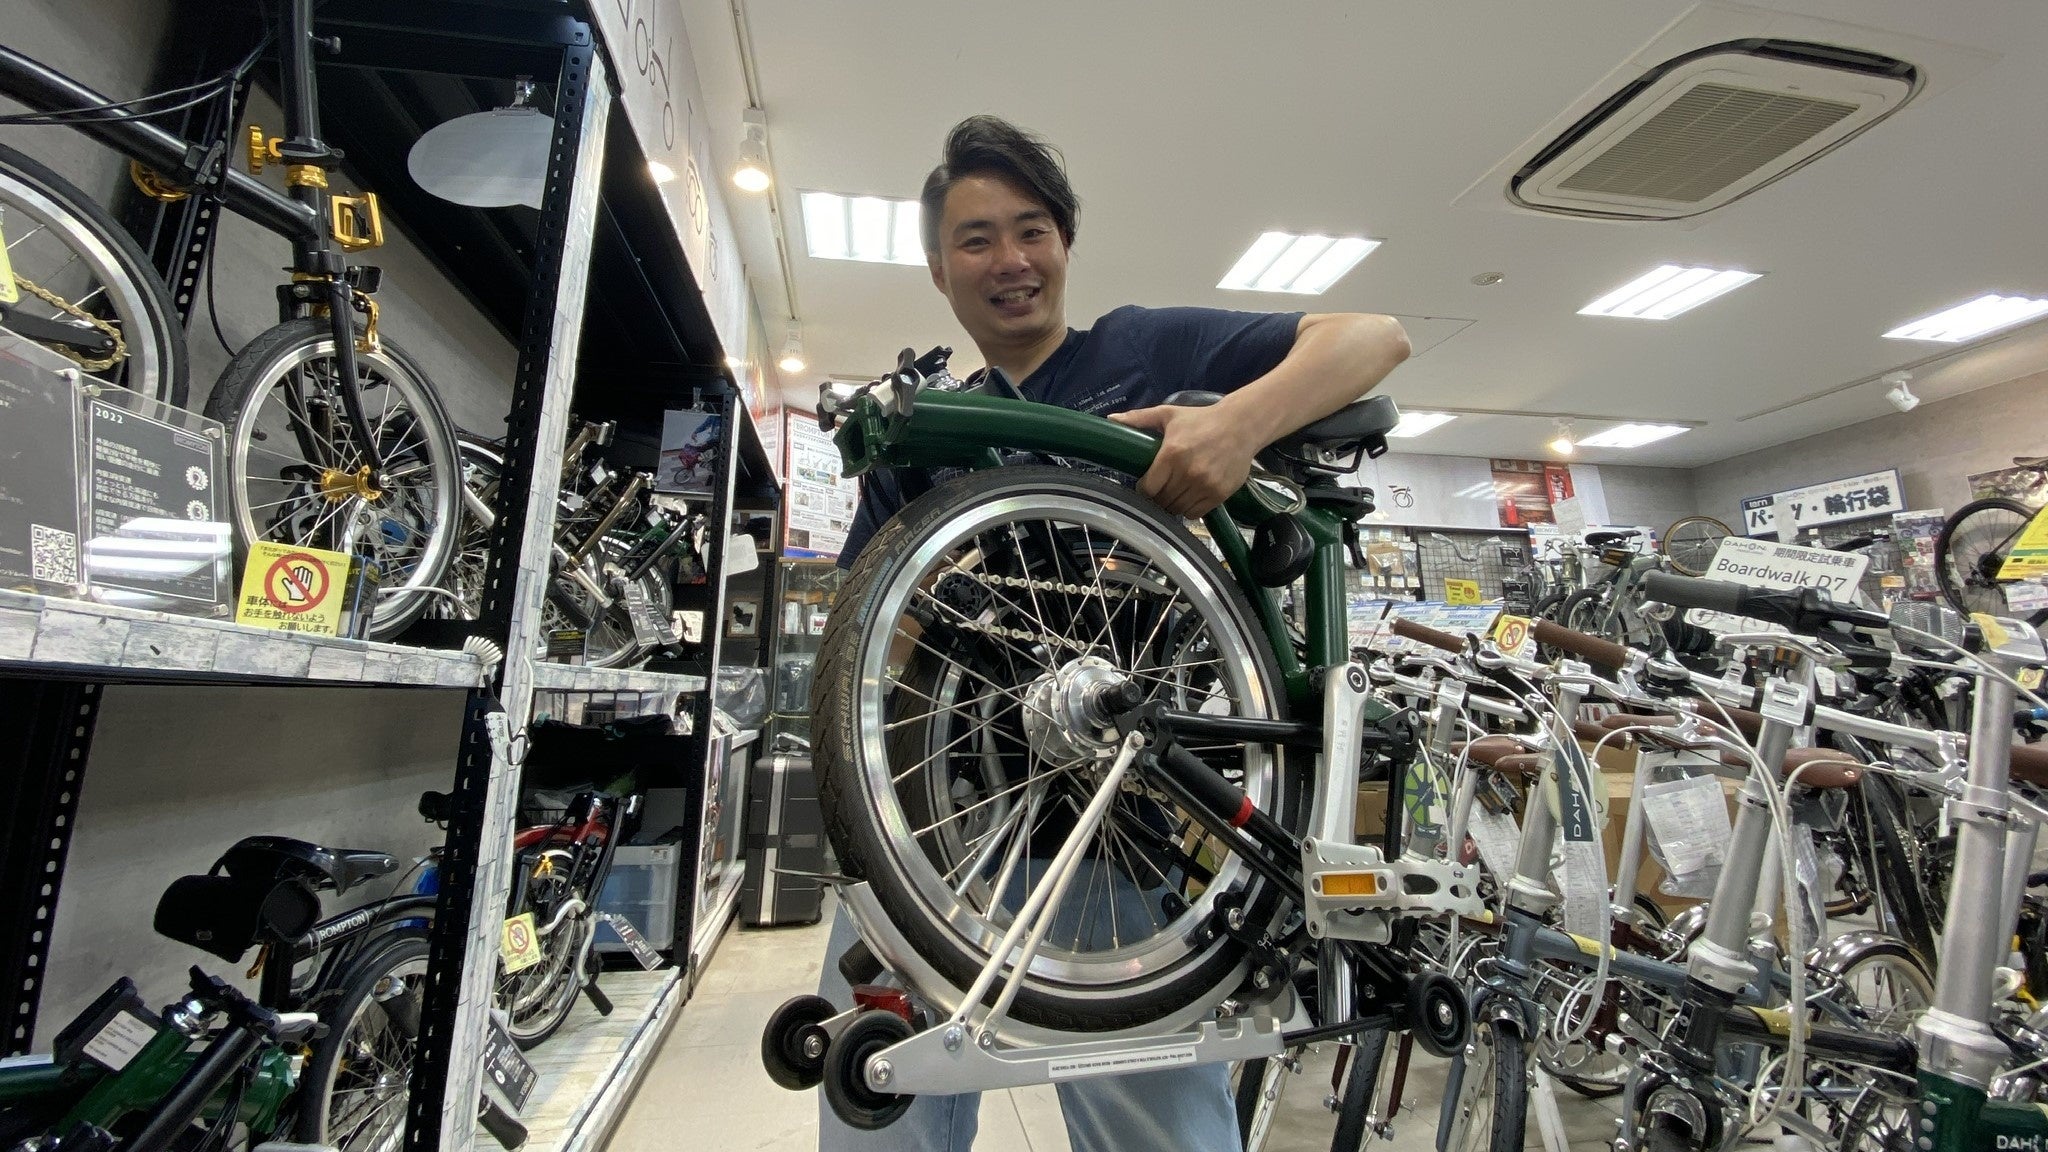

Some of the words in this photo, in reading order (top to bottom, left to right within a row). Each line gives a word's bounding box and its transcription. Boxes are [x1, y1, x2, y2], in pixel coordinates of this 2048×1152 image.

[95, 408, 124, 424] 2022
[1723, 540, 1767, 551] DAHON
[1773, 547, 1857, 568] 期間限定試乗車
[1716, 558, 1811, 586] Boardwalk
[1816, 575, 1848, 592] D7
[243, 608, 325, 622] お手を触れないよう
[279, 621, 335, 634] お願いします。
[318, 913, 366, 940] ROMPTON
